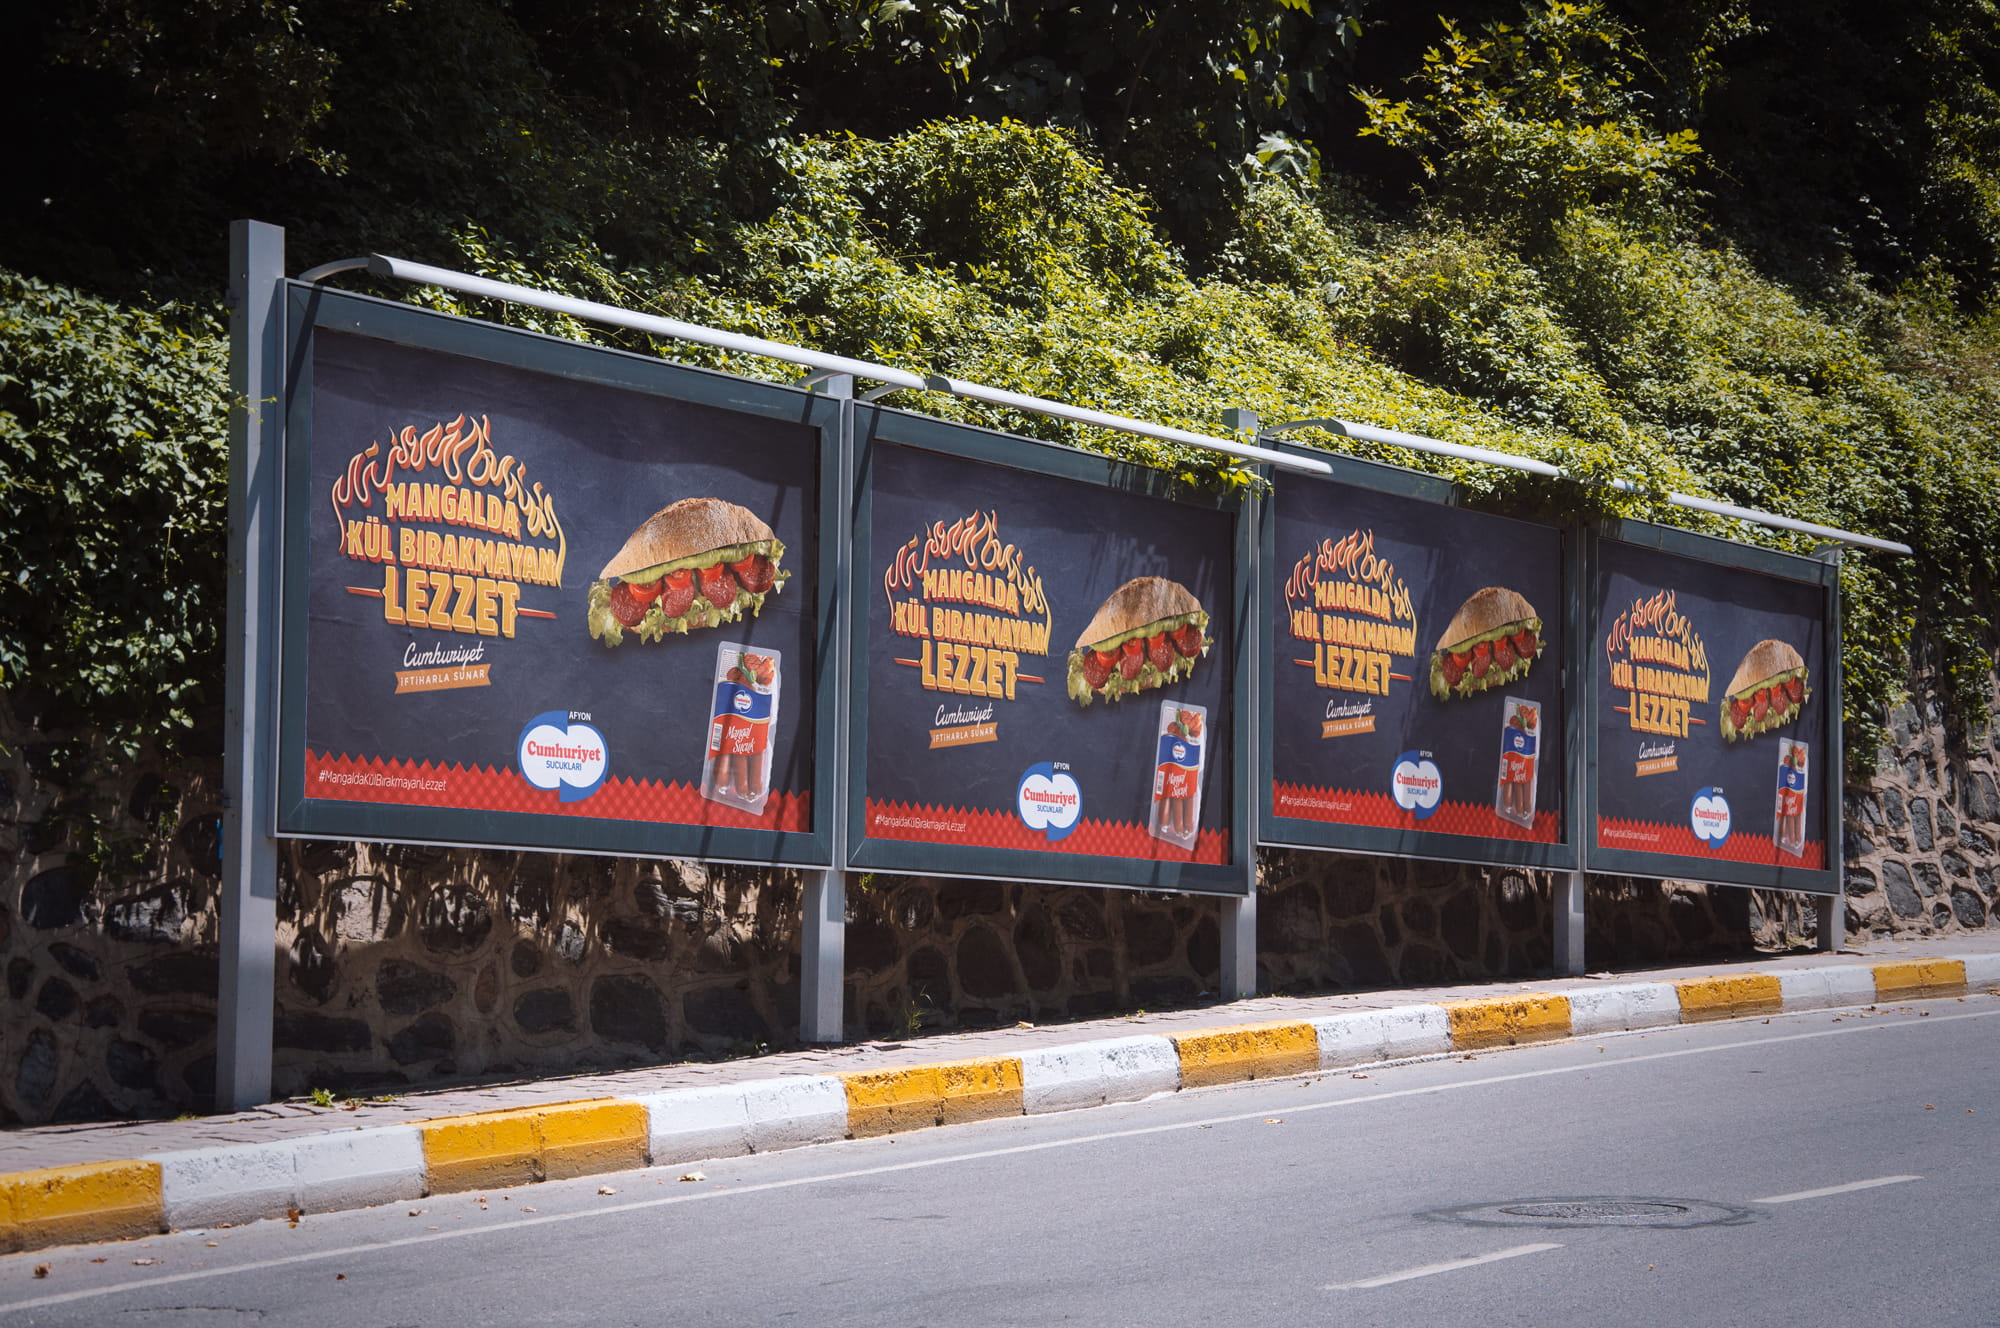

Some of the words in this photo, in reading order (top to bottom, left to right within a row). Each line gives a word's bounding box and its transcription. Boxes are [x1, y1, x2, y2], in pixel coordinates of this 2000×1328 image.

[385, 482, 521, 541] MANGALDA
[346, 515, 396, 565] KÜL
[400, 527, 557, 588] BIRAKMAYAN
[382, 565, 520, 638] LEZZET
[922, 569, 1020, 617] MANGALDA
[1315, 581, 1392, 623] MANGALDA
[895, 597, 930, 638] KÜL
[932, 607, 1046, 655] BIRAKMAYAN
[1293, 606, 1322, 641] KÜL
[1323, 614, 1413, 657] BIRAKMAYAN
[403, 640, 485, 671] Cumhuriyet
[920, 640, 1019, 700] LEZZET
[1314, 643, 1392, 696] LEZZET
[1630, 636, 1690, 673] MANGALDA
[453, 669, 485, 681] SUNAR
[1613, 659, 1636, 691] KÜL
[568, 711, 592, 721] AFYON
[935, 702, 993, 728] Cumhuriyet
[1629, 691, 1691, 739] LEZZET
[527, 740, 601, 763] Cumhuriyet
[545, 760, 582, 771] SUCUKLARI
[1023, 787, 1077, 807] Cumhuriyet
[1396, 772, 1439, 790] Cumhuriyet
